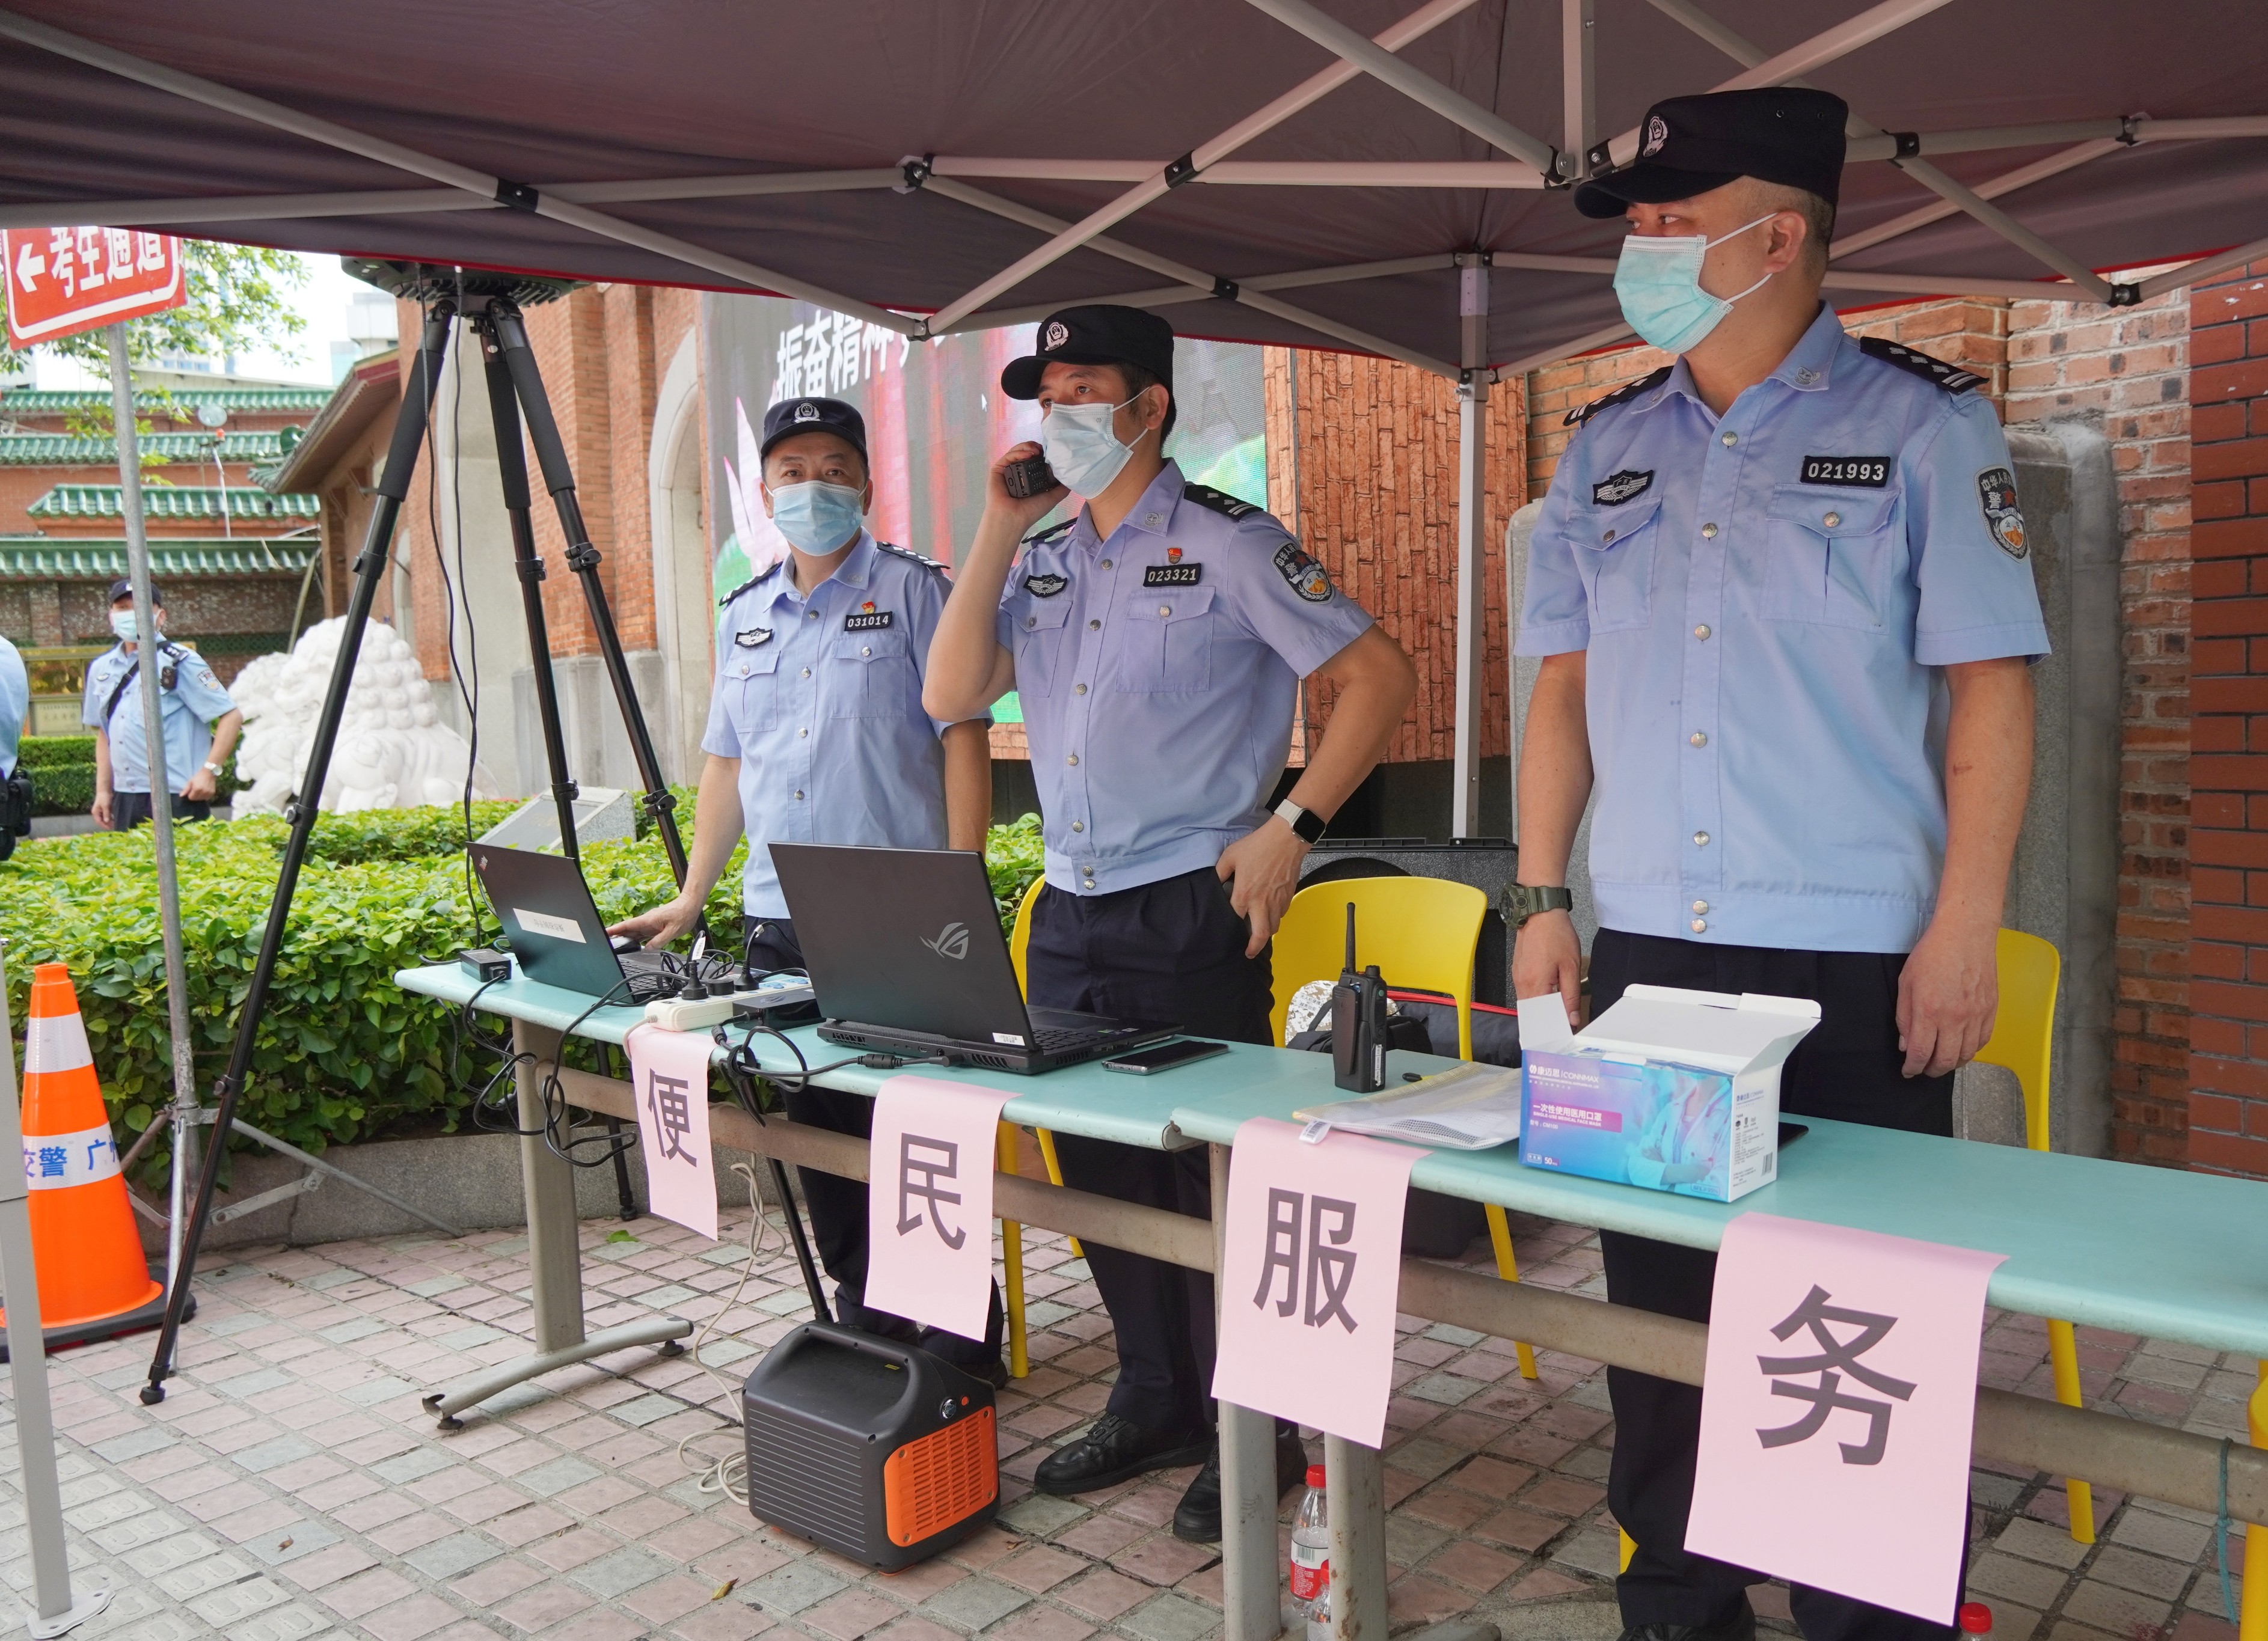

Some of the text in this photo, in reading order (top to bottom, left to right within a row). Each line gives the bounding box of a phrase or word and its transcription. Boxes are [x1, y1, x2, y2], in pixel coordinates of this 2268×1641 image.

[1808, 462, 1884, 480] 021993
[1148, 569, 1196, 582] 023321
[848, 615, 889, 628] 031014
[1563, 1071, 1599, 1083] CONNMAX
[648, 1068, 697, 1167] 便
[1533, 1103, 1602, 1122] 一次性使用医用口罩
[1533, 1111, 1557, 1120] SINGLE-USE
[1558, 1115, 1577, 1123] MEDICAL
[1544, 1157, 1552, 1165] 50
[896, 1132, 966, 1250] 民
[1253, 1187, 1358, 1334] 服
[1755, 1283, 1918, 1465] 务
